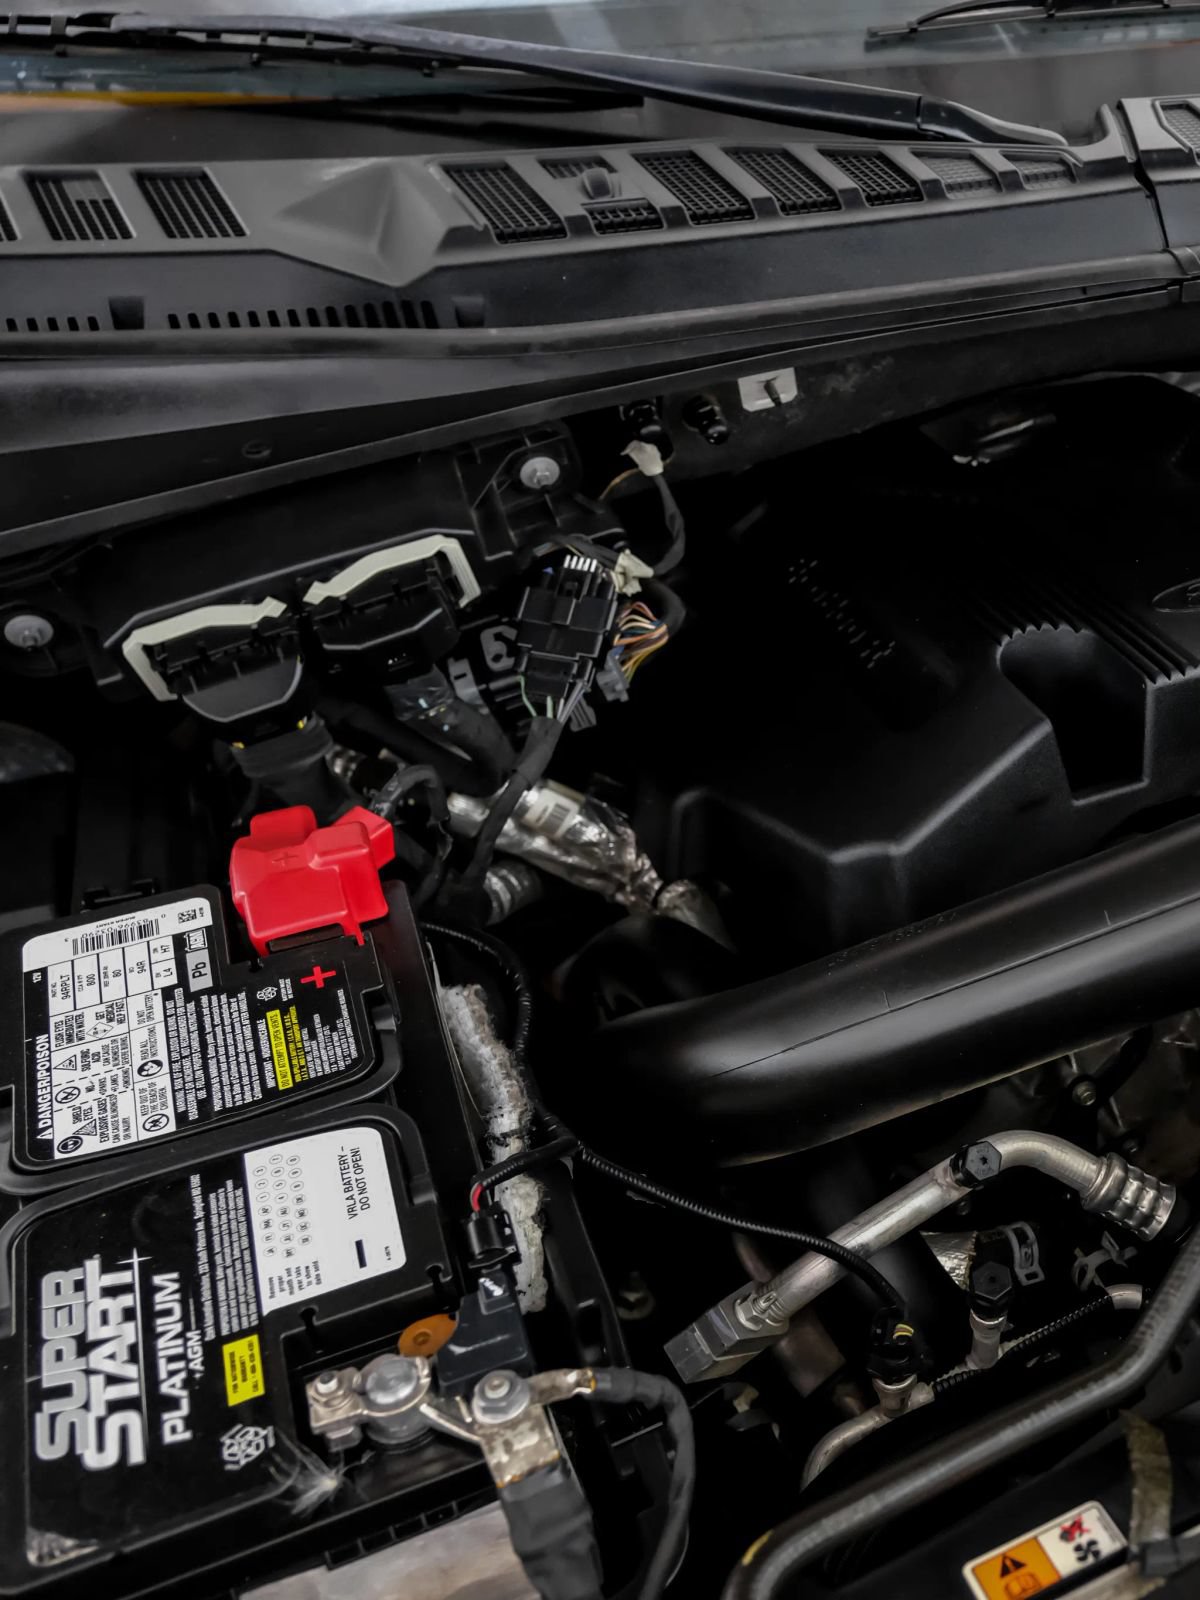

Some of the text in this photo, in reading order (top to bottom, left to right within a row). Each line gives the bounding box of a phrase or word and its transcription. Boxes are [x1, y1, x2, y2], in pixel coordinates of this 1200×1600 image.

[160, 943, 170, 953] H7
[32, 971, 41, 983] 12V
[112, 968, 121, 977] 80
[136, 960, 146, 974] 94R
[163, 967, 172, 977] L4
[190, 960, 207, 978] Pb
[60, 973, 70, 1000] 94RPLT
[86, 973, 95, 986] 800
[95, 1010, 104, 1020] GET
[105, 1002, 115, 1023] MEDICAL
[115, 999, 125, 1024] HELP FAST.
[136, 1009, 145, 1024] DO NOT
[144, 992, 154, 1022] OPEN BATTERY.
[64, 1014, 74, 1045] IMMEDIATELY
[75, 1011, 85, 1042] WITH WATER.
[269, 1013, 279, 1029] VENTS.
[147, 1025, 158, 1058] INSTRUCTIONS.
[257, 1018, 270, 1058] NONSERVICEABLE
[272, 1028, 281, 1042] OPEN
[80, 1048, 90, 1072] SULFURIC
[91, 1050, 100, 1063] ACID
[139, 1038, 149, 1060] READ ALL
[275, 1047, 286, 1069] ATTEMPT
[102, 1056, 110, 1066] CAN
[35, 1033, 52, 1128] DANGER/POISON
[263, 1060, 275, 1088] IMPORTANT
[279, 1068, 288, 1079] NOT
[280, 1078, 289, 1087] DO
[138, 1086, 146, 1094] OF
[147, 1080, 158, 1113] THE REACH OF
[157, 1085, 168, 1111] CHILDREN.
[71, 1105, 82, 1124] SHIELD
[83, 1104, 92, 1121] EYES.
[97, 1097, 109, 1142] EXPLOSIVE GASES
[109, 1094, 120, 1143] CAN CAUSE BLINDNESS
[139, 1103, 148, 1116] KEEP
[337, 1152, 353, 1193] BATTERY
[350, 1146, 370, 1210] DO NOT OPEN!
[344, 1193, 358, 1219] VRLA
[266, 1275, 276, 1299] Remove
[276, 1274, 285, 1293] proper
[286, 1278, 294, 1295] month
[294, 1265, 304, 1291] year tabs
[153, 1271, 193, 1444] PLATINUM
[186, 1330, 203, 1371] AGM
[36, 1269, 86, 1461] SUPER
[83, 1257, 146, 1471] START
